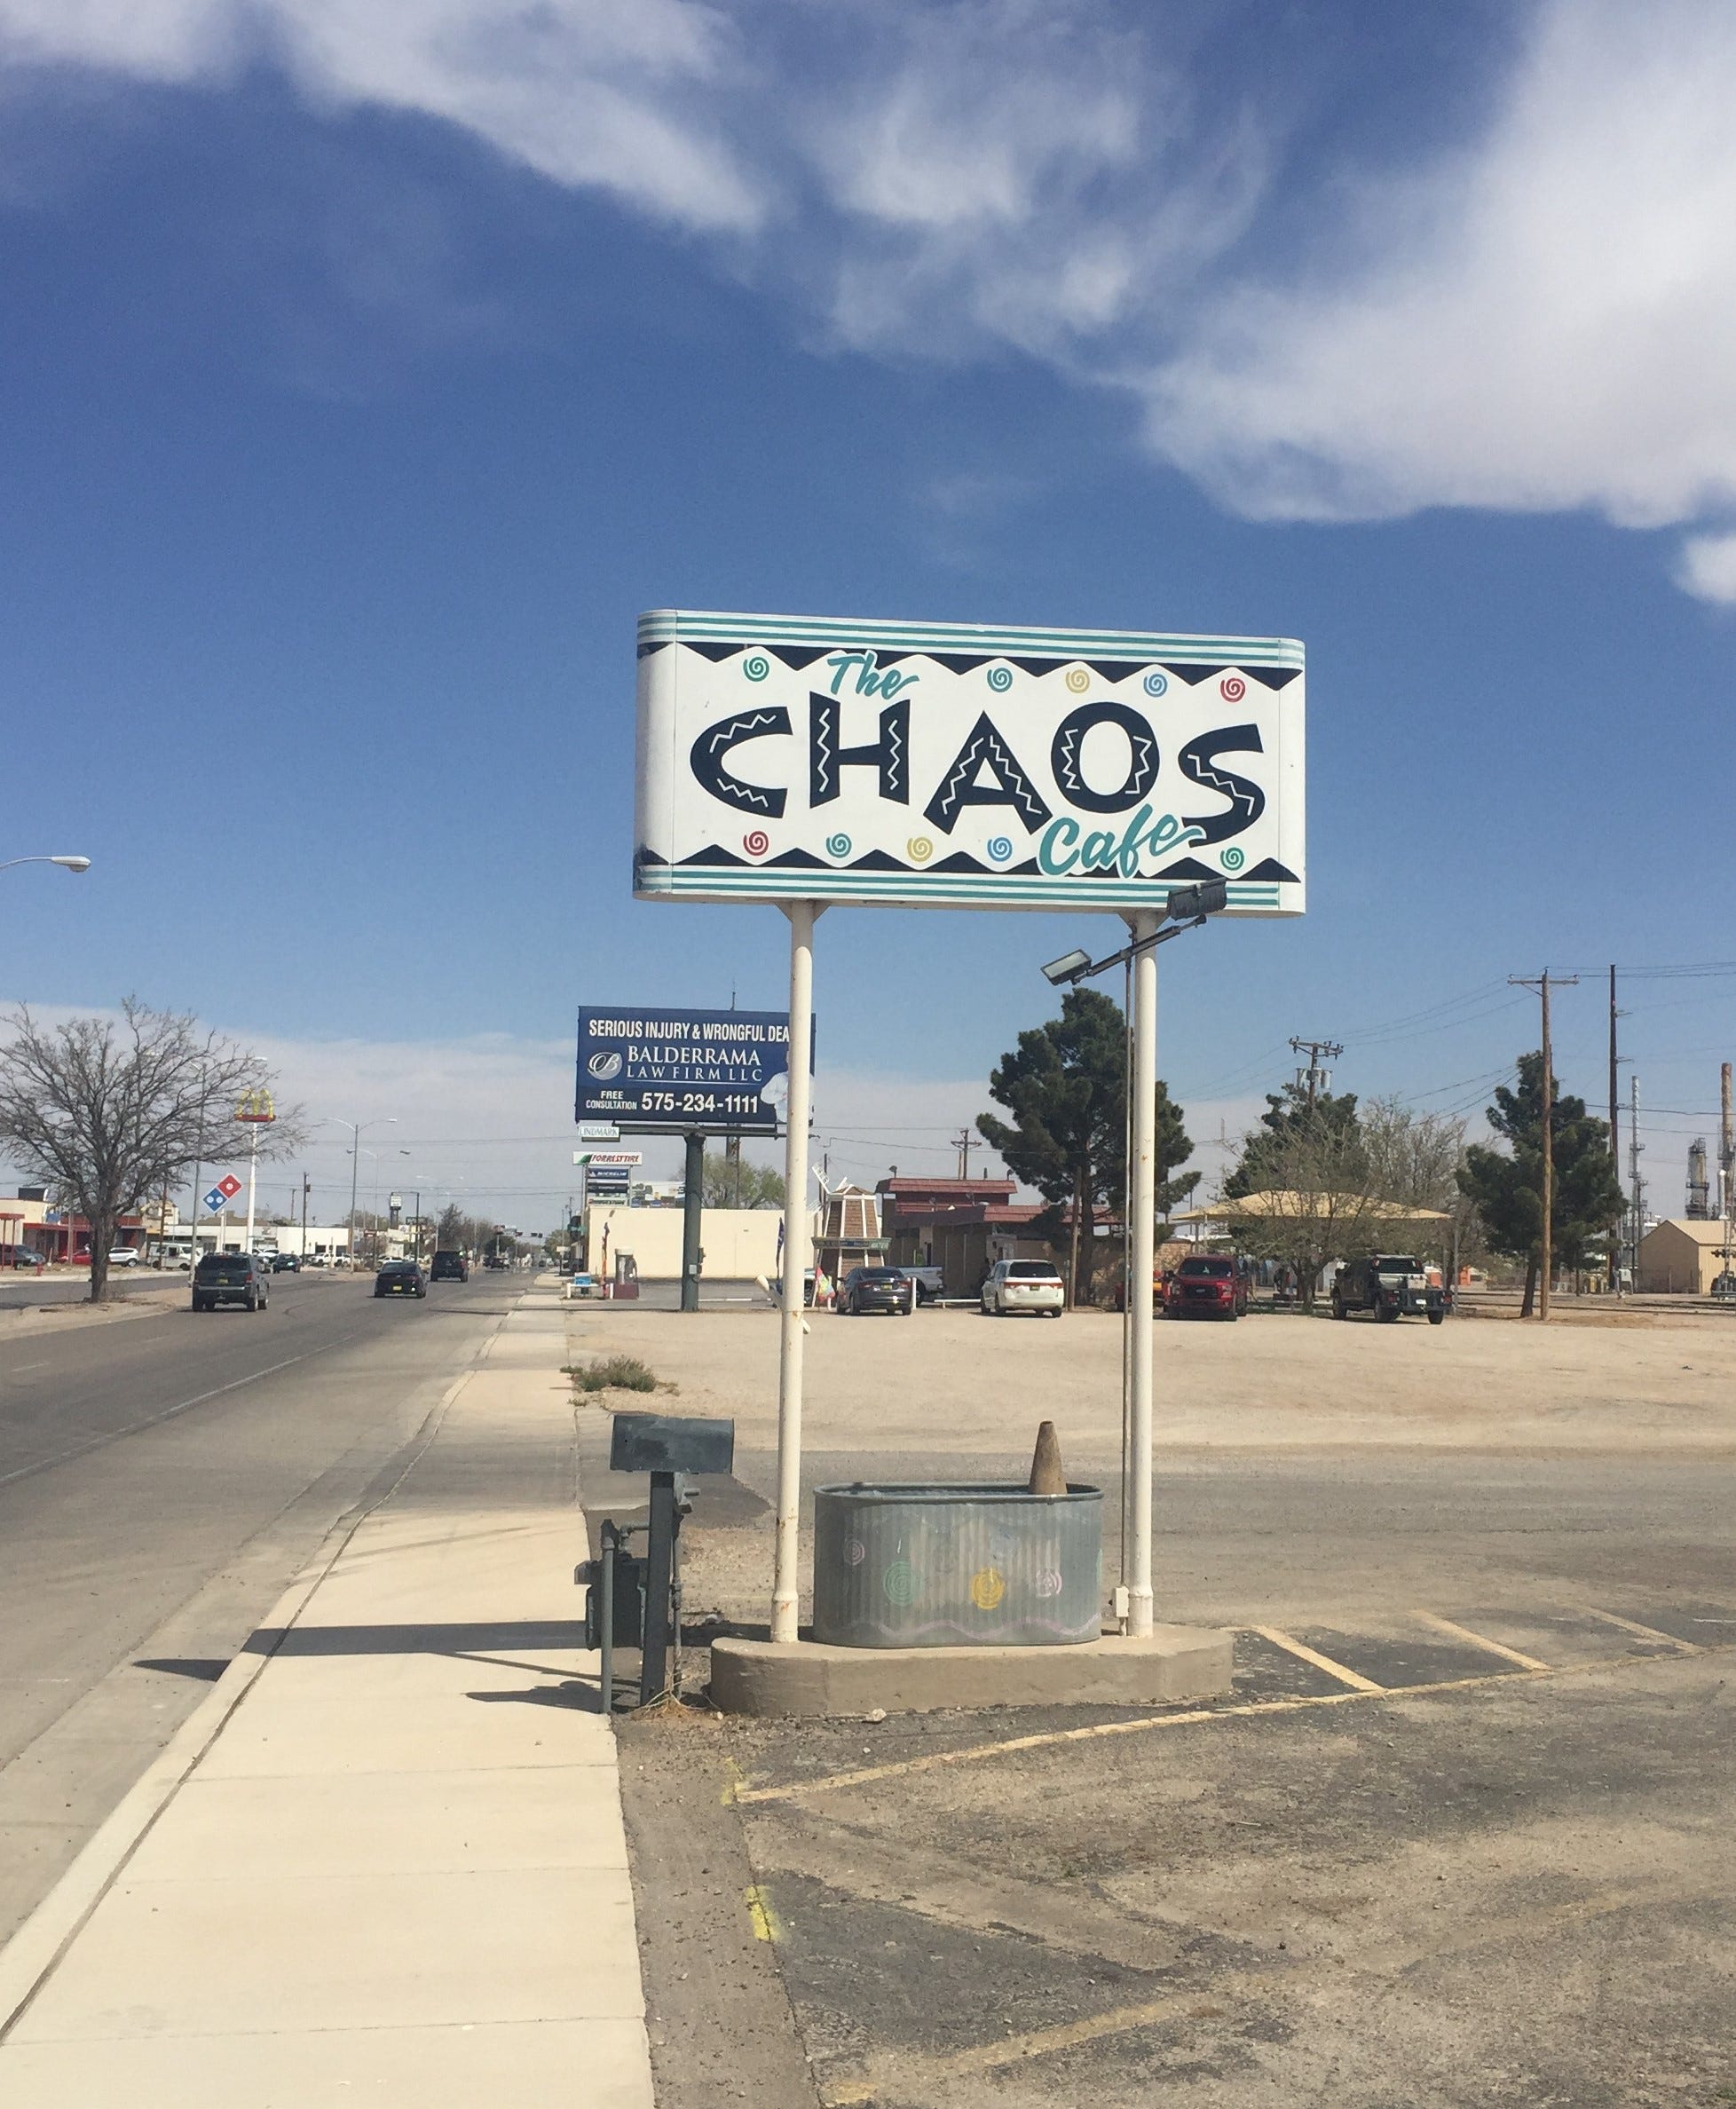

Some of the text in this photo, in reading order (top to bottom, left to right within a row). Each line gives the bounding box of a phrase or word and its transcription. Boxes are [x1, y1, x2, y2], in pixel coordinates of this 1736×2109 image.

[828, 651, 919, 699] The
[690, 691, 1264, 848] CHAOS
[1038, 803, 1204, 877] Cafe
[589, 1019, 790, 1043] SERIOUS INJURY & WRONGFUL DEA
[627, 1045, 761, 1066] BALDERRAMA
[627, 1065, 762, 1082] LAW FIRM LLC
[586, 1100, 637, 1110] CONSULTATION
[601, 1090, 624, 1100] FREE
[642, 1092, 758, 1114] 575-234-1111
